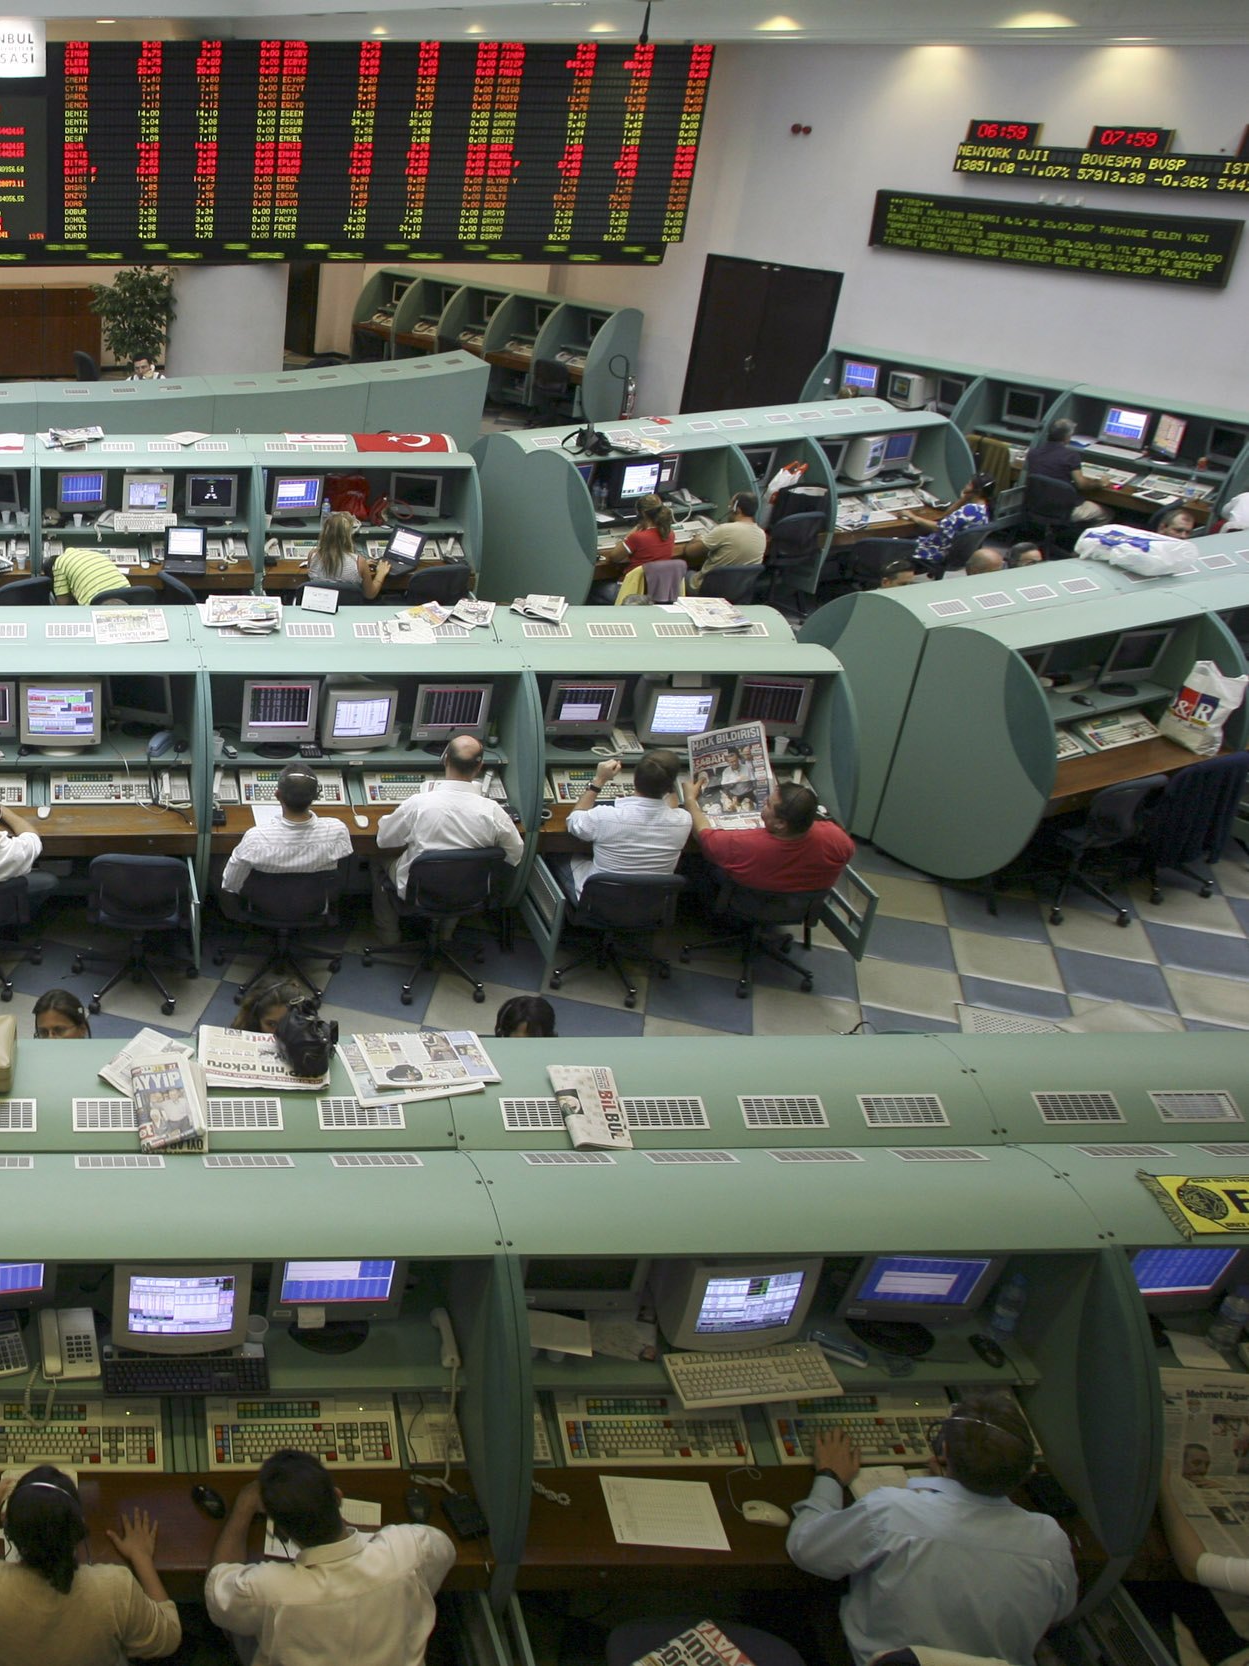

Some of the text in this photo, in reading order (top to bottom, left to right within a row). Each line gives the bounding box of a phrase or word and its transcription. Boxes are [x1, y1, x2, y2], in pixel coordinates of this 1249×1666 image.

[977, 124, 1029, 140] 06:59
[1101, 129, 1159, 147] 07:59
[958, 142, 1012, 159] NEWYORK
[1016, 148, 1050, 162] DJII
[1080, 153, 1142, 169] BOVESPA
[1148, 158, 1187, 171] BVSP
[954, 159, 1014, 174] 13851.08
[1022, 164, 1070, 178] -1.07%
[1077, 168, 1146, 185] 57913.38
[1154, 174, 1210, 189] -0.36%
[1158, 250, 1222, 263] 400.000.000
[692, 735, 714, 751] HALK
[207, 1058, 258, 1074] rekoru
